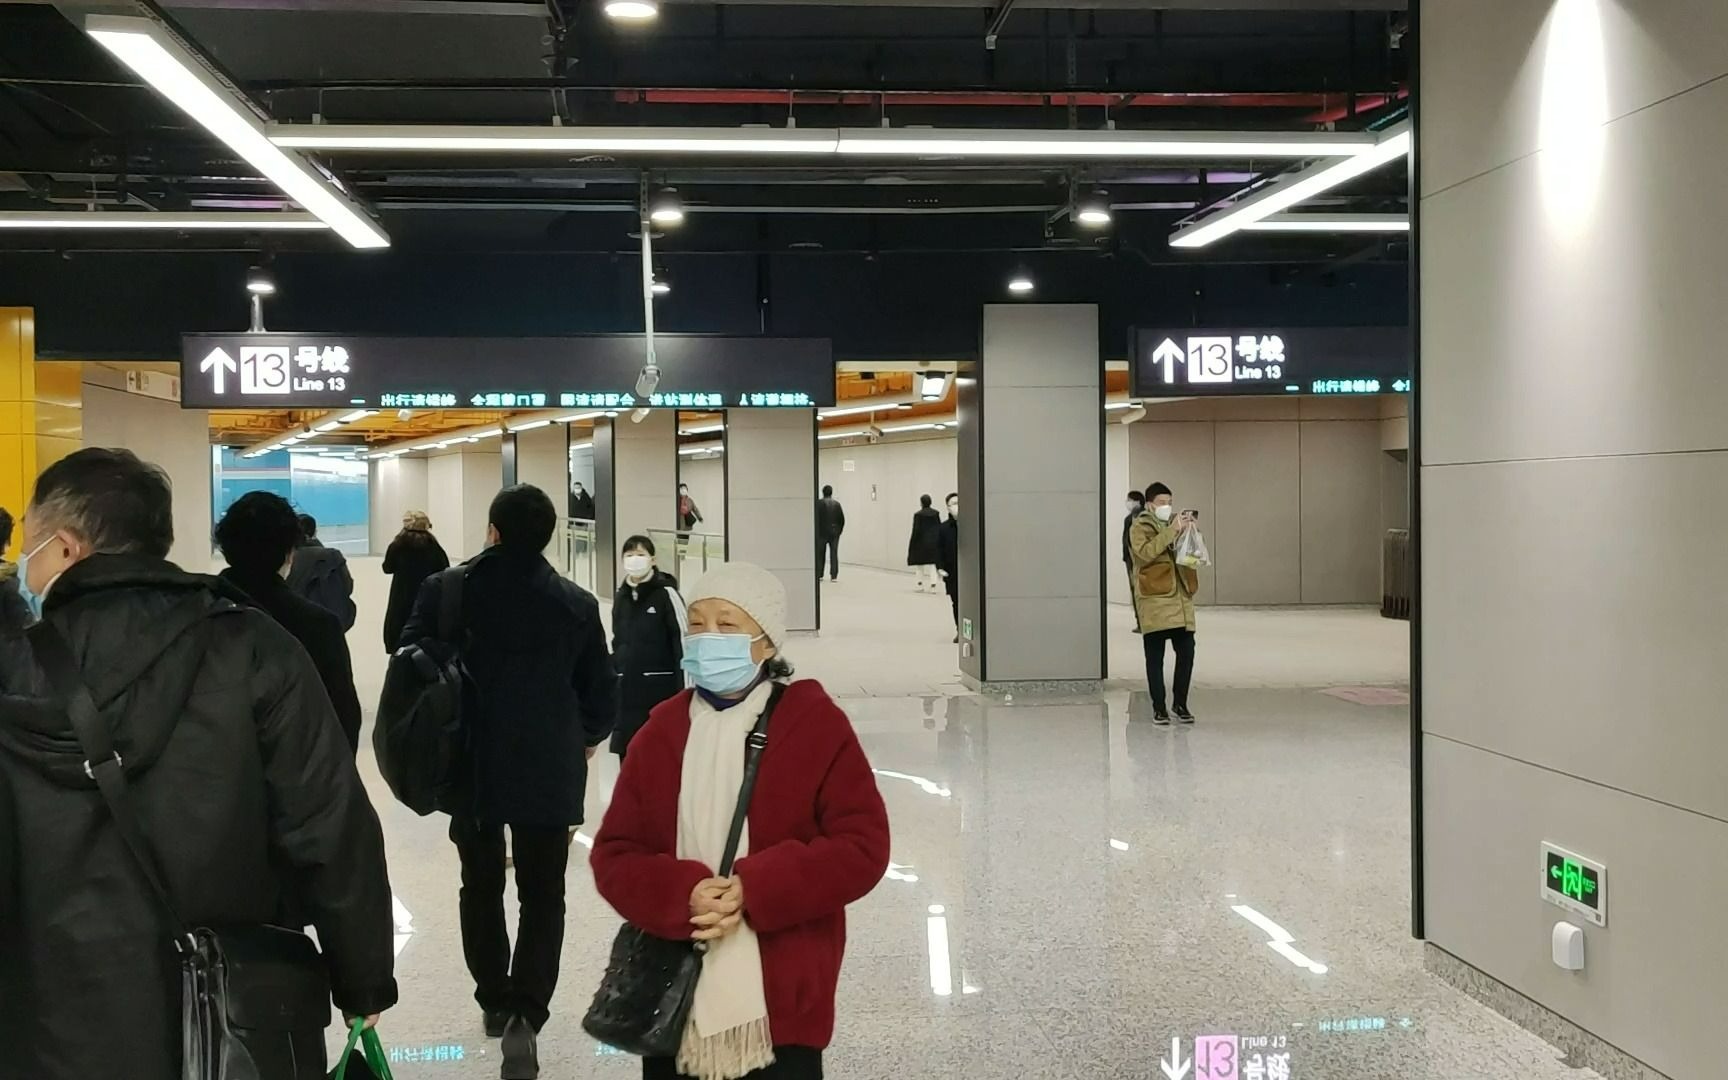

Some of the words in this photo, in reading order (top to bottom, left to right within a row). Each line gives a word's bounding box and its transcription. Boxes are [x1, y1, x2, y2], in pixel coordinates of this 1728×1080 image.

[244, 353, 285, 388] 13
[294, 346, 350, 373] 号线
[1190, 344, 1229, 376] 13
[1235, 335, 1285, 362] 号线
[294, 377, 323, 391] Line
[327, 377, 346, 391] 13
[1234, 365, 1263, 380] Line
[1265, 365, 1282, 380] 13
